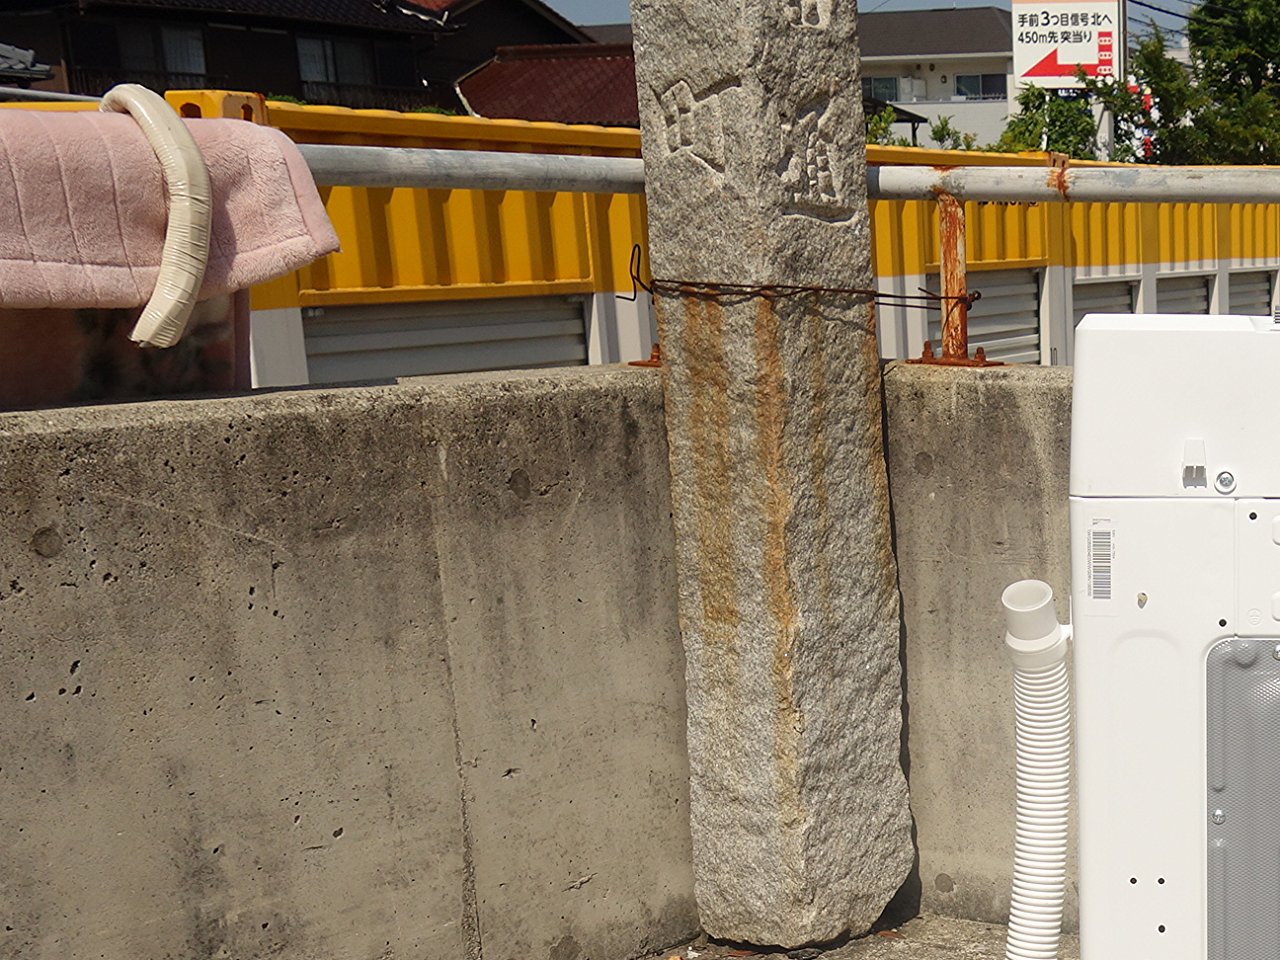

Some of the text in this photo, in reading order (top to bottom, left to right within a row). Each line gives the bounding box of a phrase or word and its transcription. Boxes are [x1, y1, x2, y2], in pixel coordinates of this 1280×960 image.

[1018, 11, 1112, 28] 手前3つ目信号北へ
